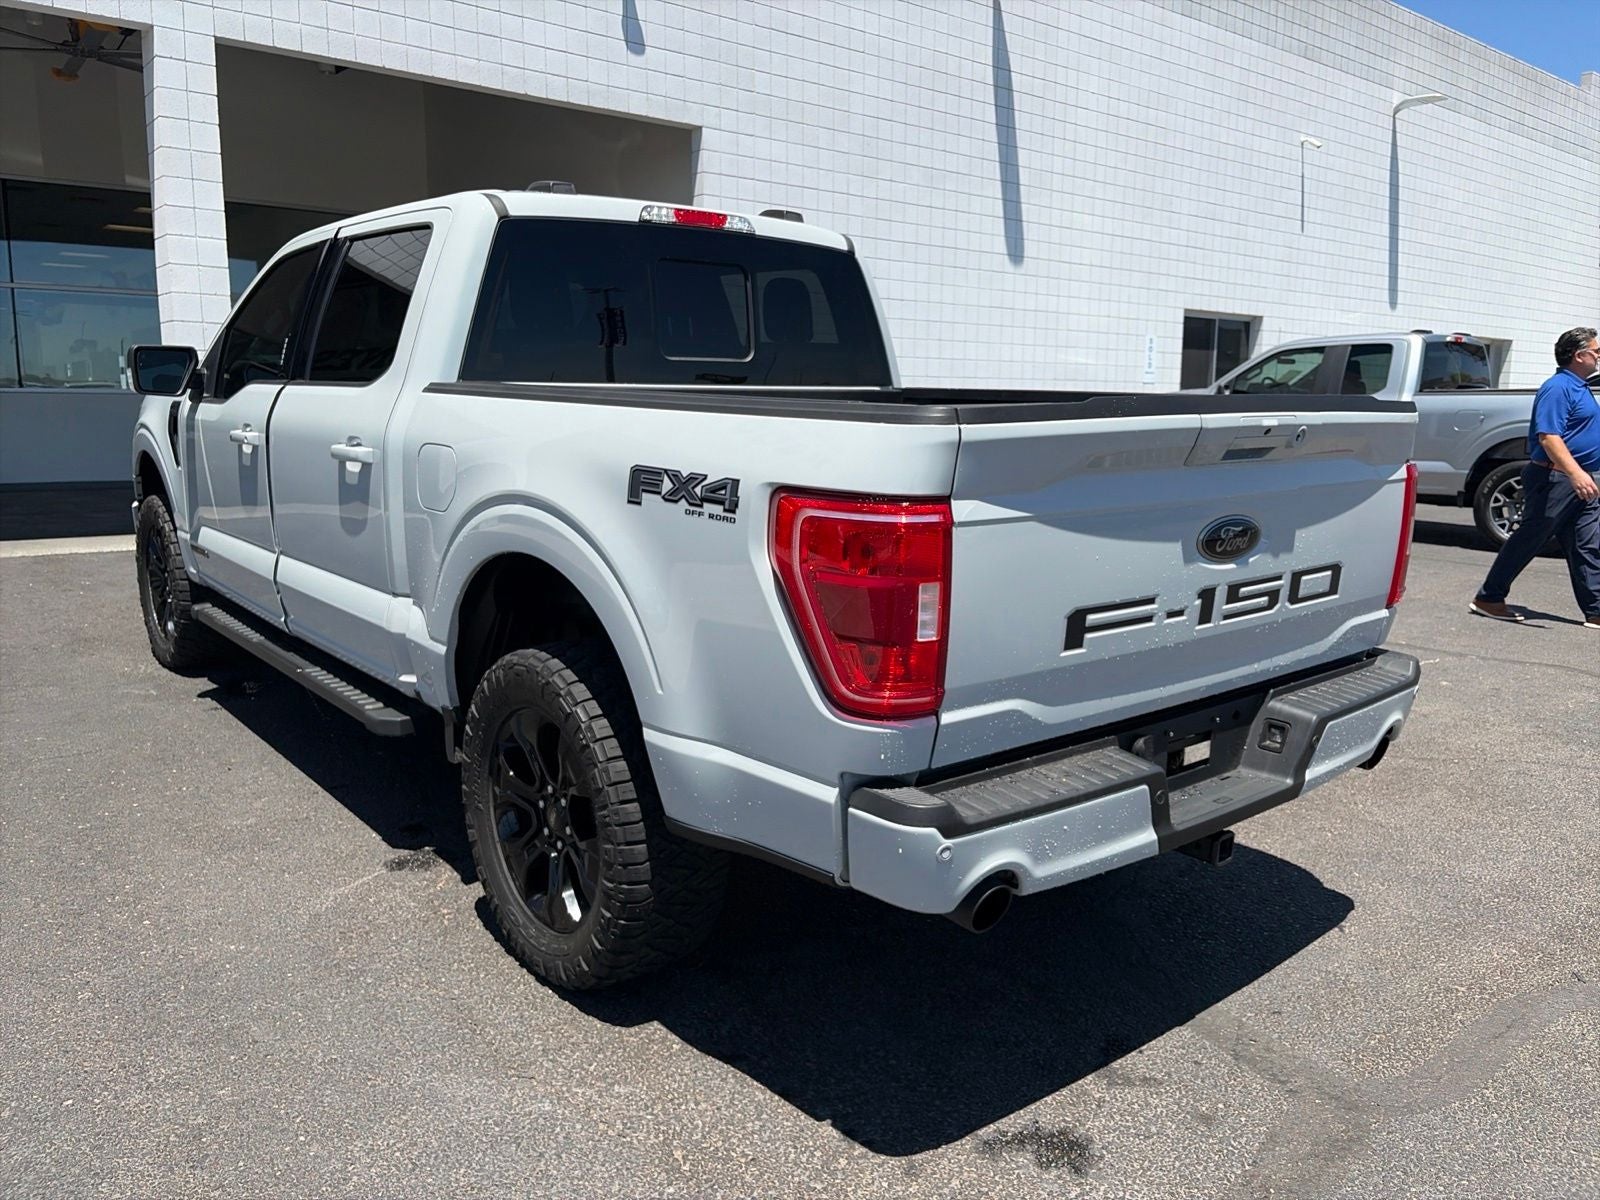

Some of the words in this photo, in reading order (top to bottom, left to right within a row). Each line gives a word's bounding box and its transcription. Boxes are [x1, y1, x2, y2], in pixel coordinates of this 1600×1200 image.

[627, 464, 740, 514] FX4
[684, 508, 705, 518] OFF
[708, 512, 736, 524] ROAD
[1216, 526, 1251, 552] Ford
[1061, 560, 1343, 655] F-150
